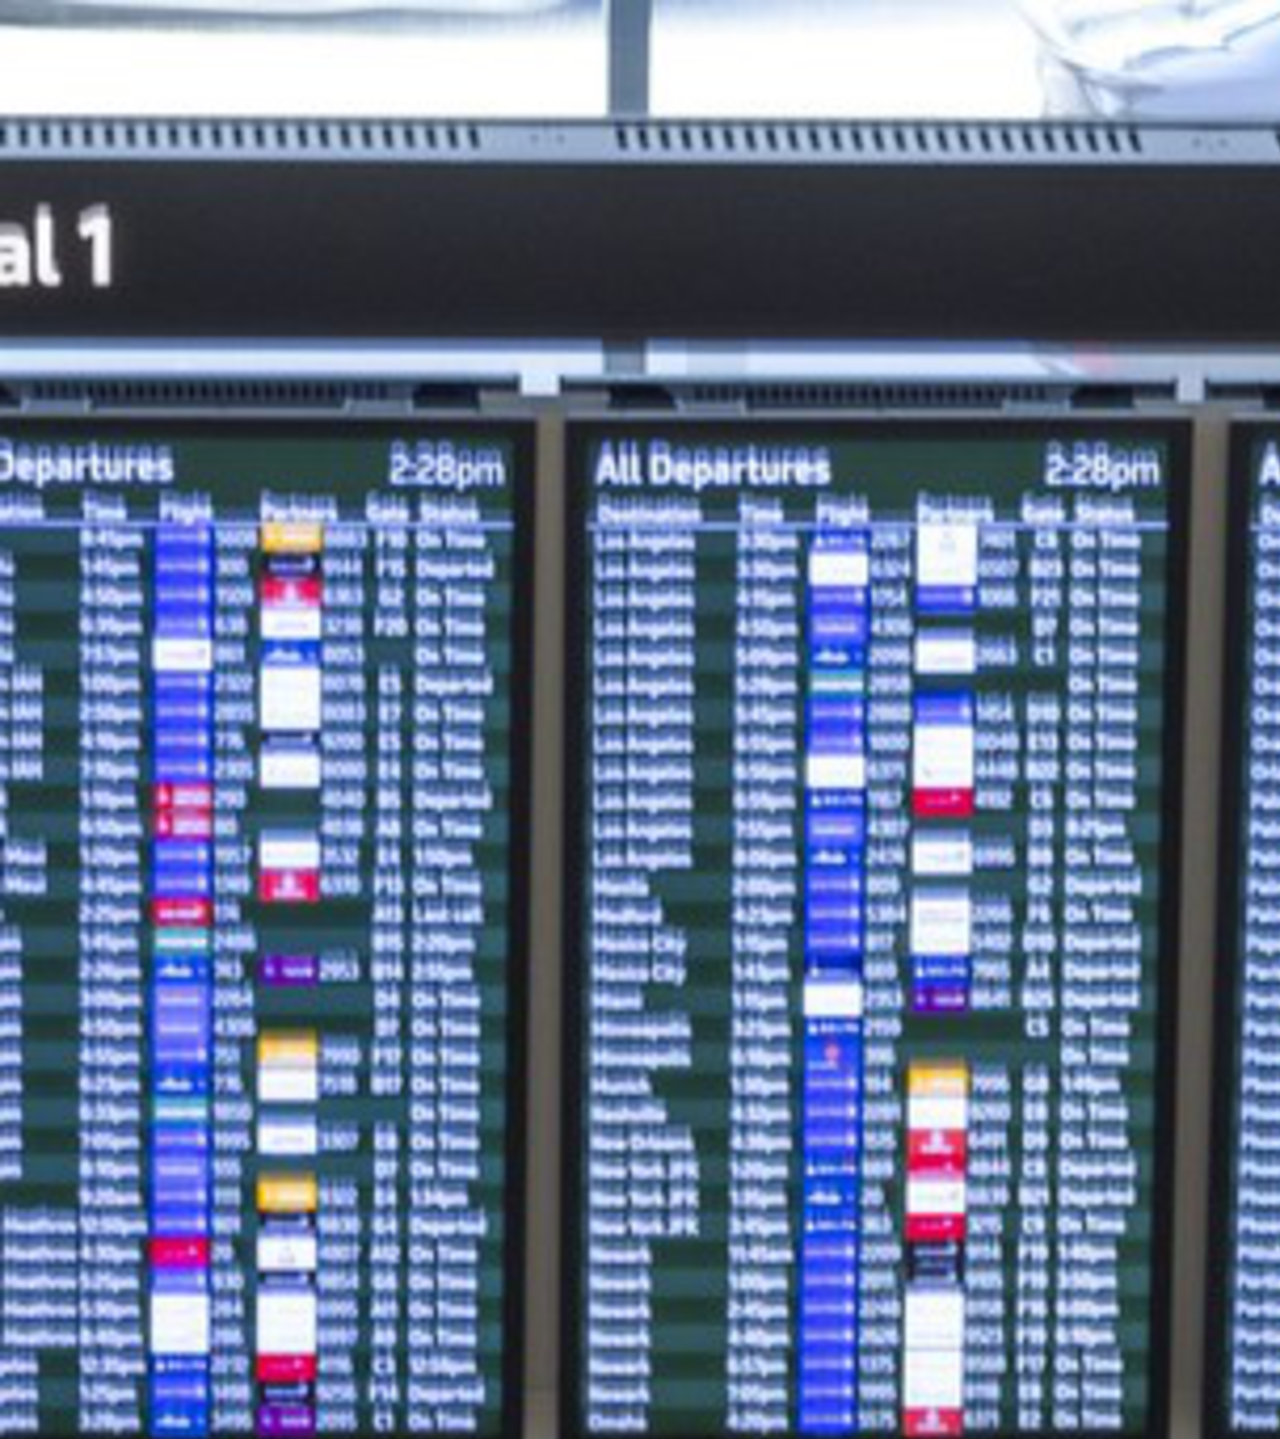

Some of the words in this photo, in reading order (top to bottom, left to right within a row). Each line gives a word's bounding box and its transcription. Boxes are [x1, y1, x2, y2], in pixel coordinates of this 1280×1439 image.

[77, 204, 111, 286] 1
[389, 445, 505, 489] 2:28pm
[596, 448, 641, 485] All
[648, 448, 831, 491] Departures
[1045, 449, 1160, 491] 2:28pm
